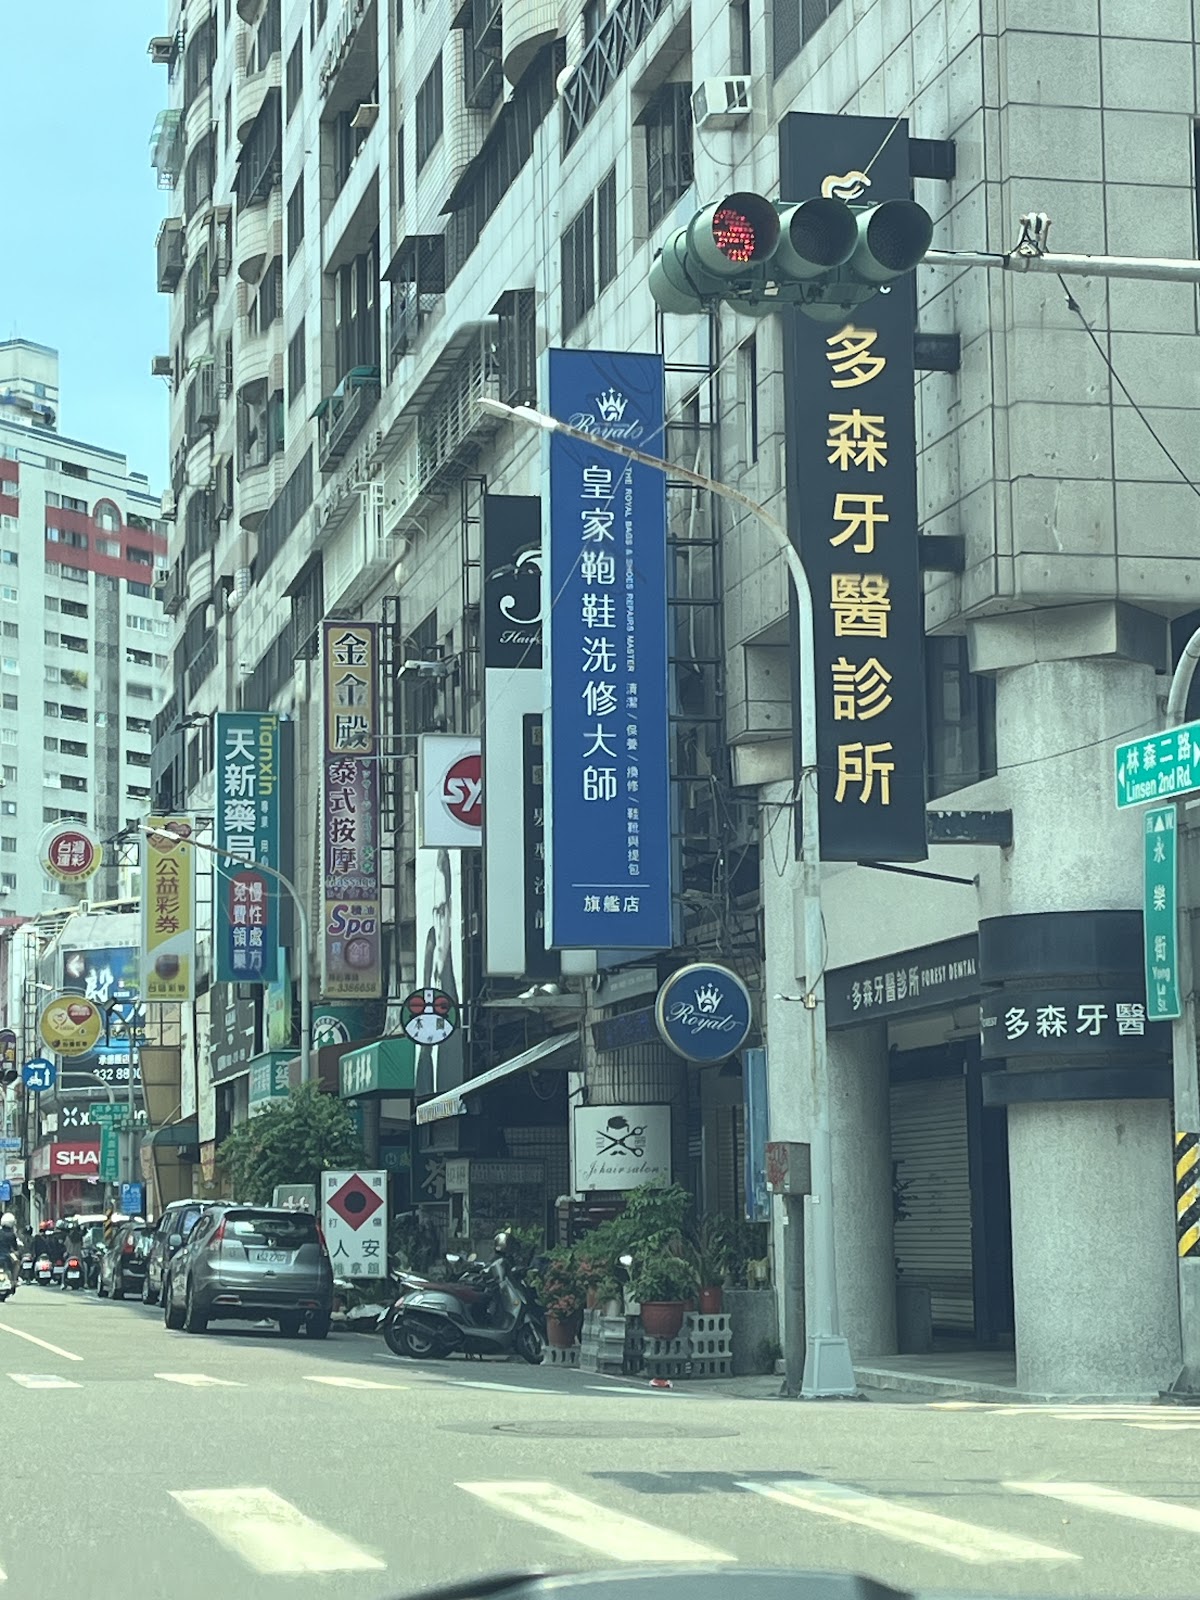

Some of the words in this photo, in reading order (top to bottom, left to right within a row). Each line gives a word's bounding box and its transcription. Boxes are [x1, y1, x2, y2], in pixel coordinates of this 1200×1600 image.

[625, 466, 633, 485] THE
[625, 487, 633, 518] ROYAL
[625, 520, 634, 546] BAGS
[825, 325, 896, 806] 多森牙醫診所
[626, 592, 636, 633] REPAIRS
[581, 465, 618, 802] 皇家鞄鞋洗修大師
[626, 634, 637, 673] MASTER
[259, 716, 278, 796] Tianxin
[1126, 731, 1192, 776] 林森二路
[223, 728, 257, 869] 天新藥局
[441, 777, 482, 812] SY
[1126, 777, 1157, 803] Linsen
[1158, 767, 1175, 794] 2nd
[1176, 764, 1192, 789] Rd.
[329, 757, 357, 875] 泰式按摩
[57, 839, 86, 854] 台灣
[155, 857, 180, 934] 公益彩券
[583, 895, 640, 913] 旗艦店
[1152, 836, 1167, 962] 永樂街
[327, 903, 376, 940] Spa
[851, 965, 920, 1011] 多森牙醫診所
[920, 965, 946, 988] FOREST
[948, 957, 977, 981] DENTAL
[667, 1001, 744, 1034] Royal
[1004, 1002, 1146, 1040] 多森牙醫
[55, 1150, 101, 1165] SHA
